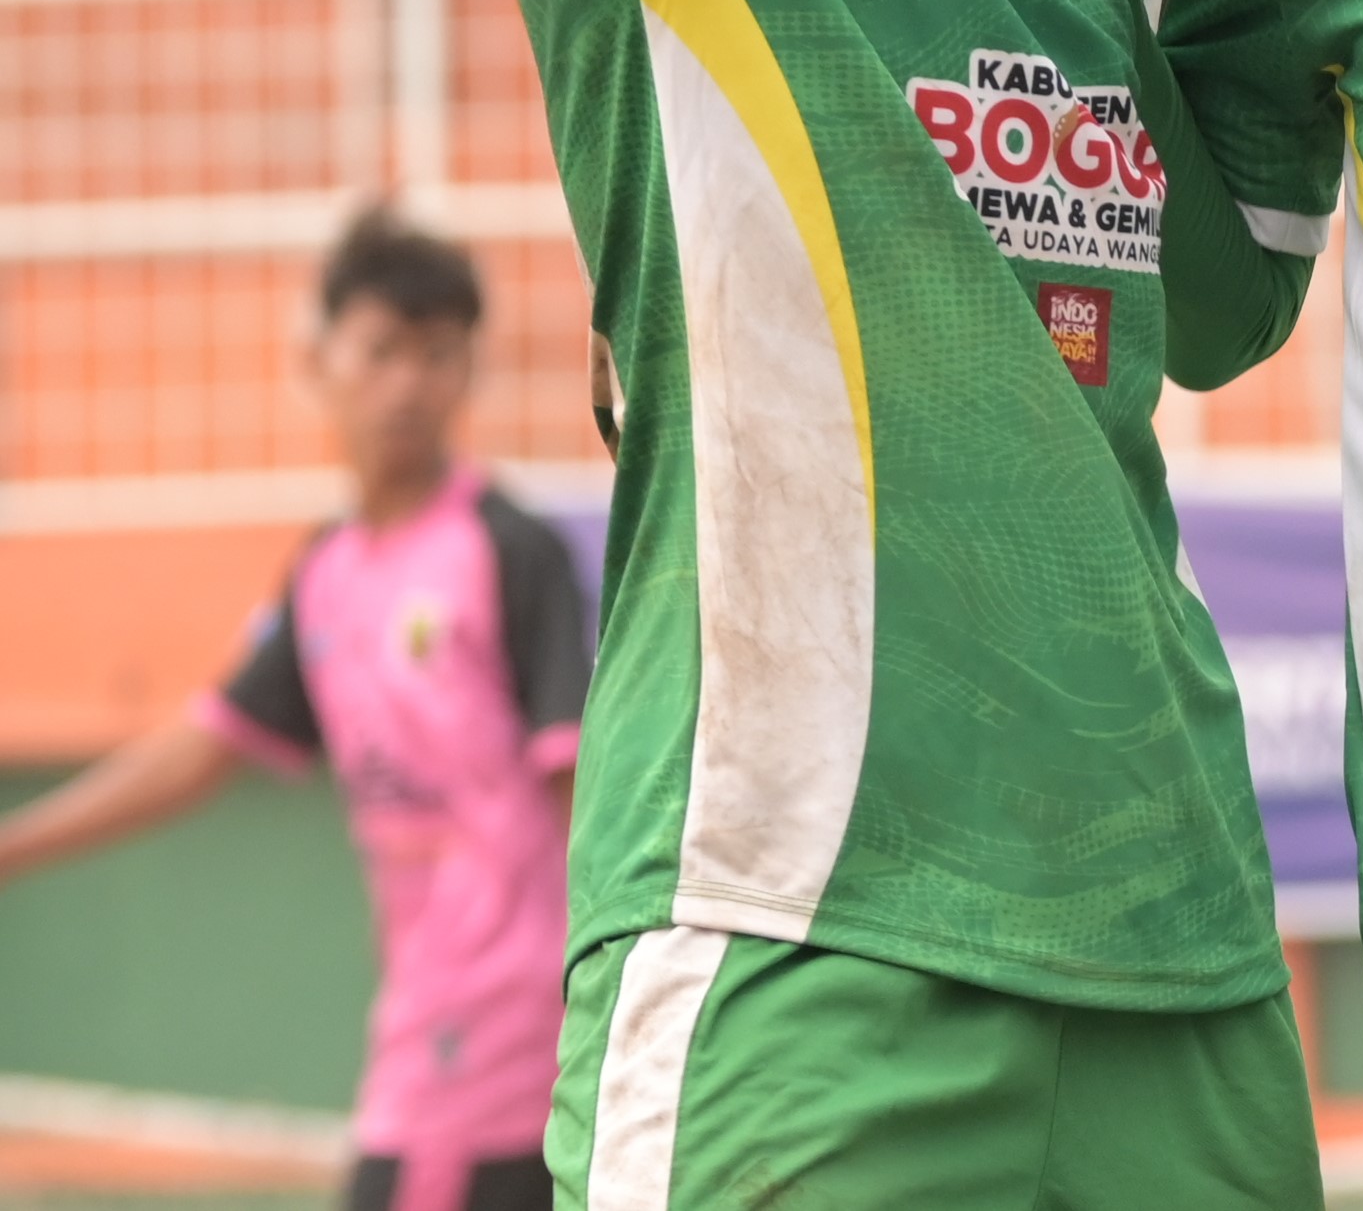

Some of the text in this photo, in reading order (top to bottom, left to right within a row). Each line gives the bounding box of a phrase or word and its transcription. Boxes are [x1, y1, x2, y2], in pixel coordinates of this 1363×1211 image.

[1068, 199, 1086, 228] &
[1024, 228, 1100, 258] UDAYA
[1050, 295, 1098, 325] INDO
